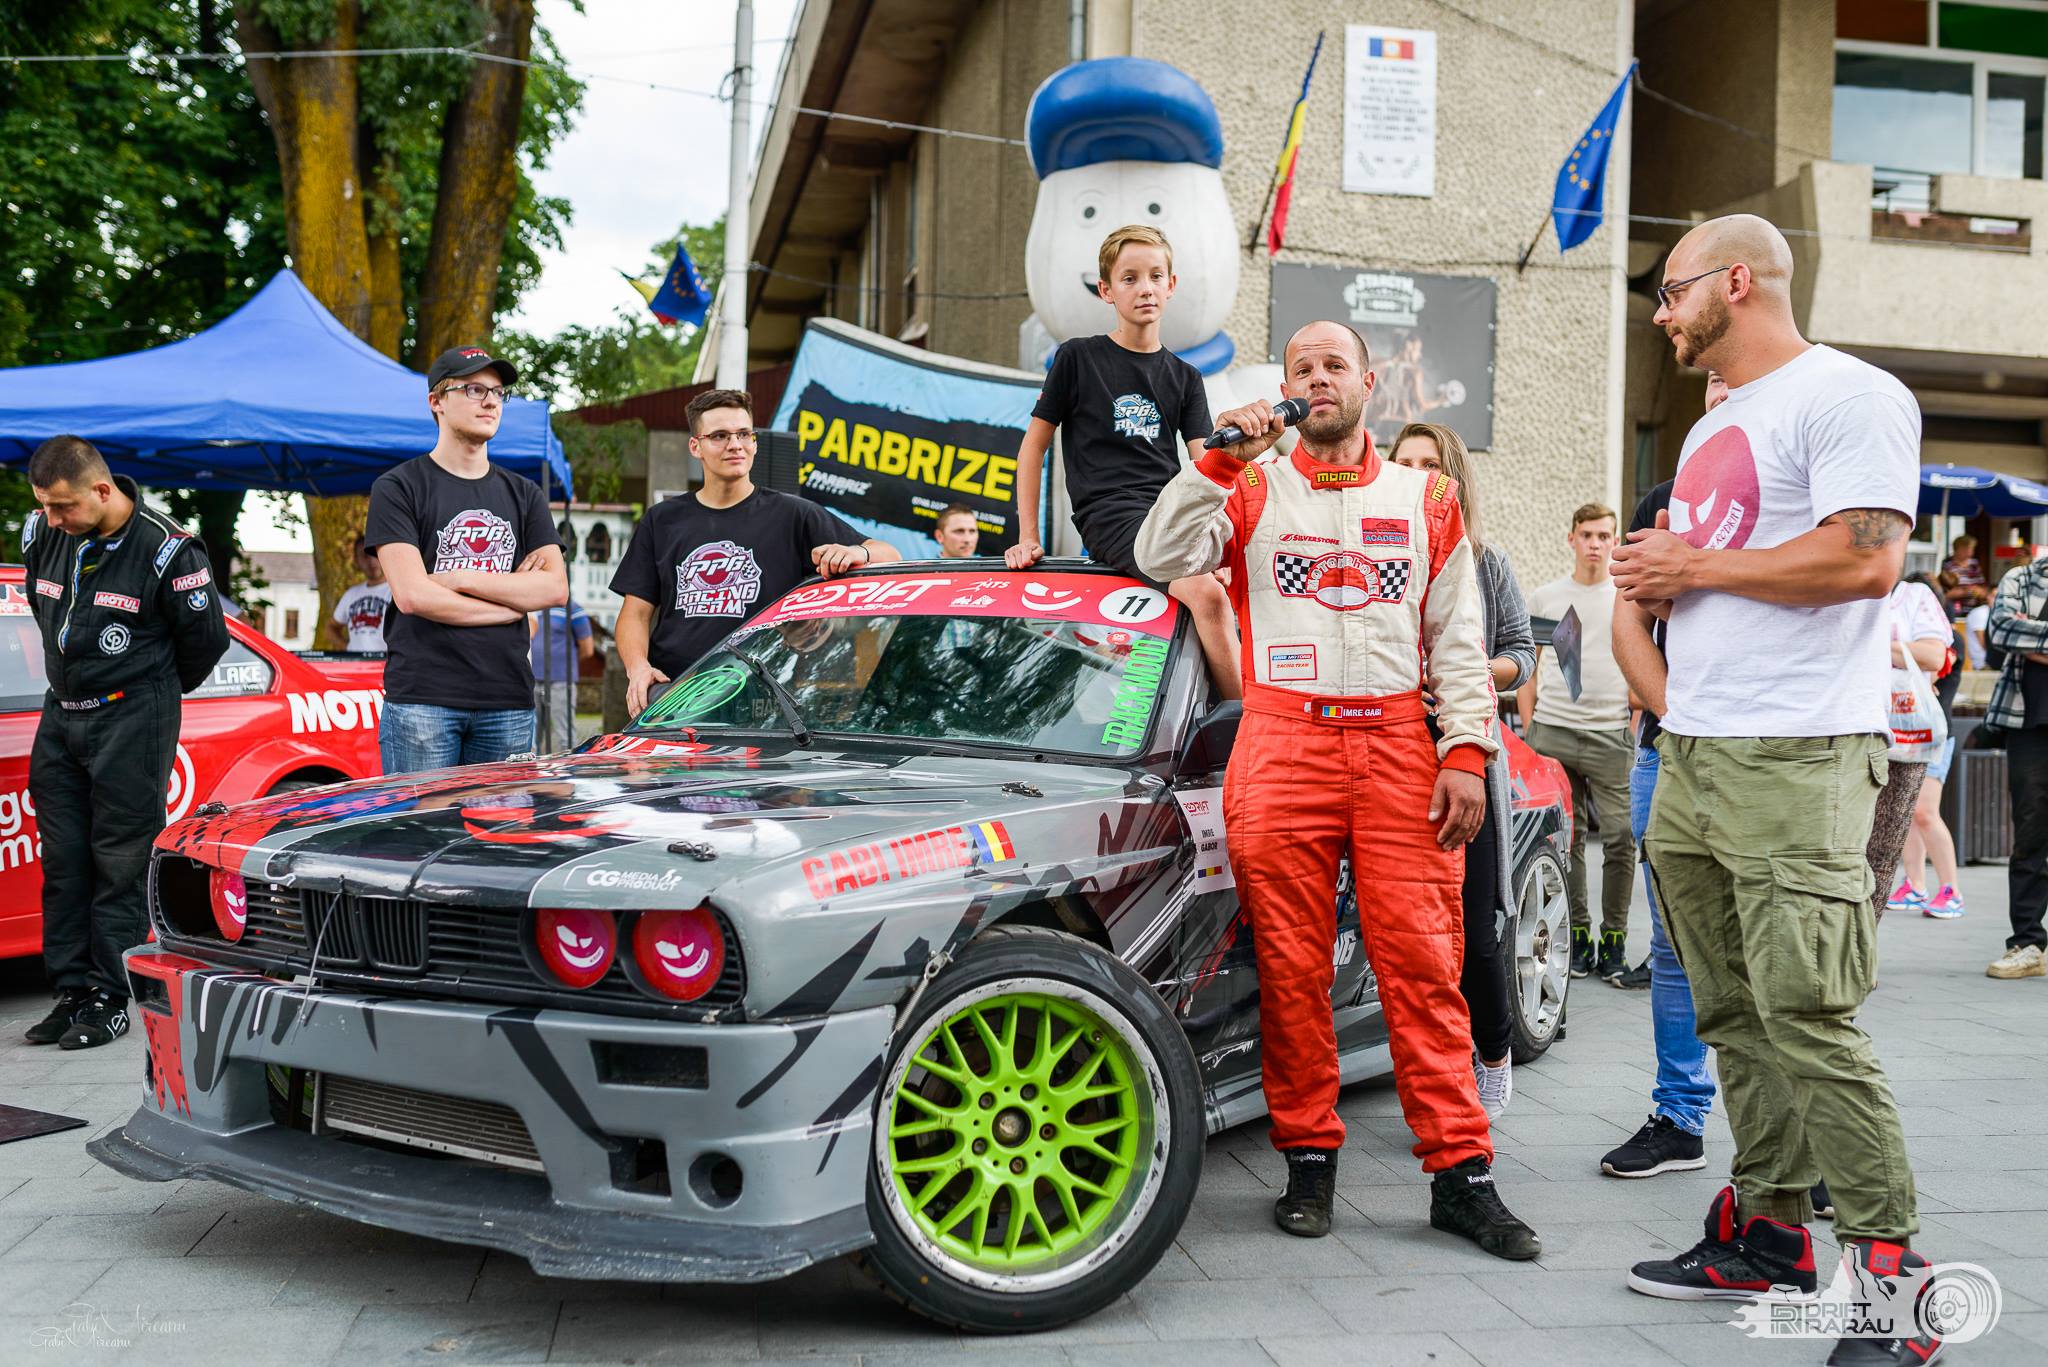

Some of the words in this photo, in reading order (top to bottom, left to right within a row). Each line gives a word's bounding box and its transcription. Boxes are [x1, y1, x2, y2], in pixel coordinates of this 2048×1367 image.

[798, 410, 1018, 501] PARBRIZE
[450, 525, 506, 546] PPG
[1365, 535, 1408, 543] ACADEMY
[685, 555, 748, 580] PPG
[97, 594, 138, 610] MOTUL
[678, 582, 758, 606] RACING
[686, 600, 743, 614] TEAM
[1118, 595, 1151, 617] 11
[1101, 639, 1169, 748] TRACKWOOD
[1364, 708, 1382, 716] GABI
[1201, 842, 1218, 852] GABOR
[801, 843, 891, 901] GABI
[890, 826, 974, 879] IMRE
[587, 869, 620, 887] CG
[620, 871, 659, 881] MEDIA
[616, 879, 678, 892] PRODUCT
